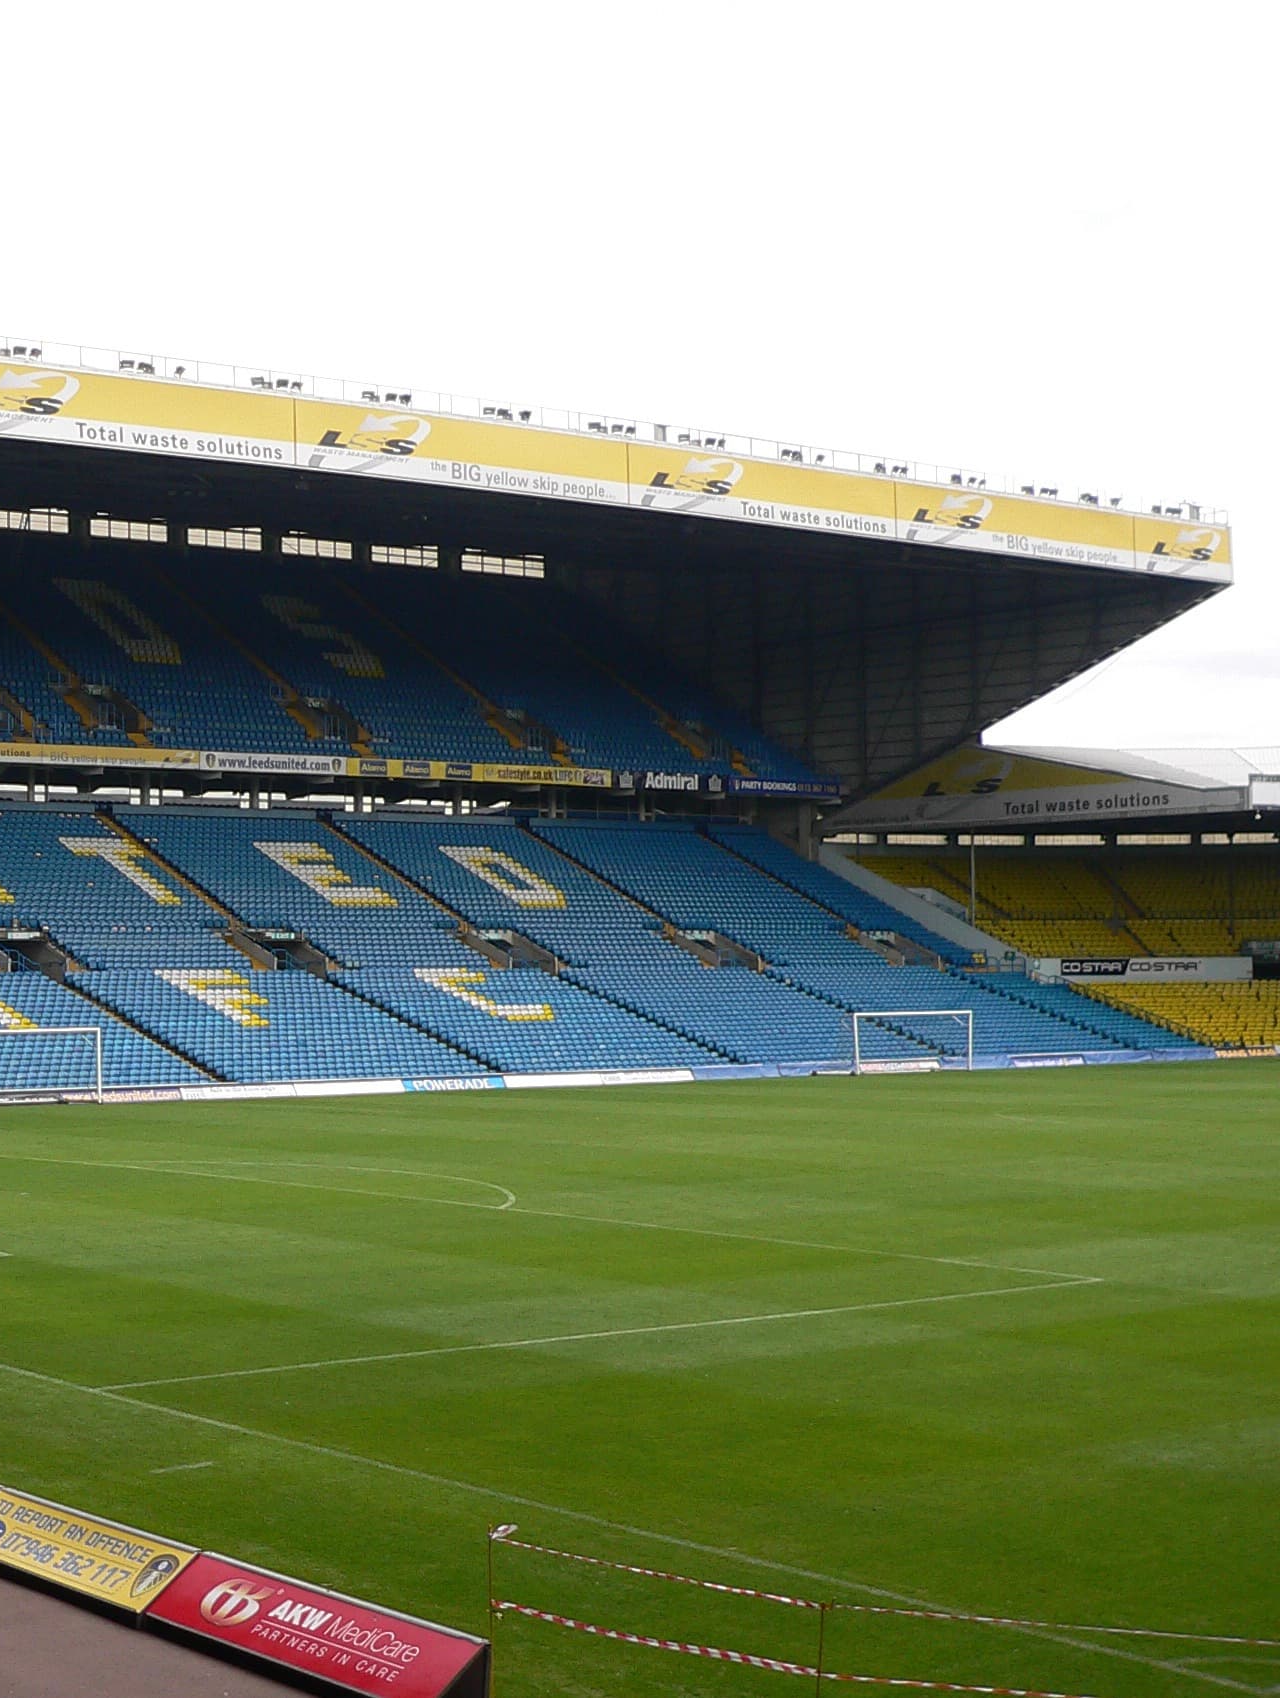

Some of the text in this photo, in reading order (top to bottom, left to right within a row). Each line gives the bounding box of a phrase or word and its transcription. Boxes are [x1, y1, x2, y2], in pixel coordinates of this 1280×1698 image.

[75, 422, 283, 460] Total waste solutions
[430, 461, 447, 473] the
[451, 462, 481, 482] BIG
[485, 470, 529, 488] yellow
[532, 475, 559, 494] skip
[740, 501, 887, 534] Total waste solutions
[992, 533, 1004, 543] the
[1007, 535, 1029, 551] BIG
[1031, 541, 1064, 558] yellow
[1065, 545, 1085, 561] skip
[50, 752, 69, 762] BIG
[218, 756, 330, 772] www.leedsunited.com
[645, 772, 699, 790] Admiral
[741, 781, 761, 790] PARTY
[763, 782, 796, 792] BOOKINGS
[1004, 793, 1170, 816] Total waste solutions
[413, 1079, 496, 1091] POWERADE
[12, 1507, 67, 1533] REPORT
[63, 1524, 87, 1543] AN
[85, 1532, 154, 1564] OFFENCE
[0, 1532, 132, 1588] 07946 362 117
[268, 1599, 420, 1664] AKW MediCare
[251, 1624, 400, 1683] PARTNERS IN CARE
